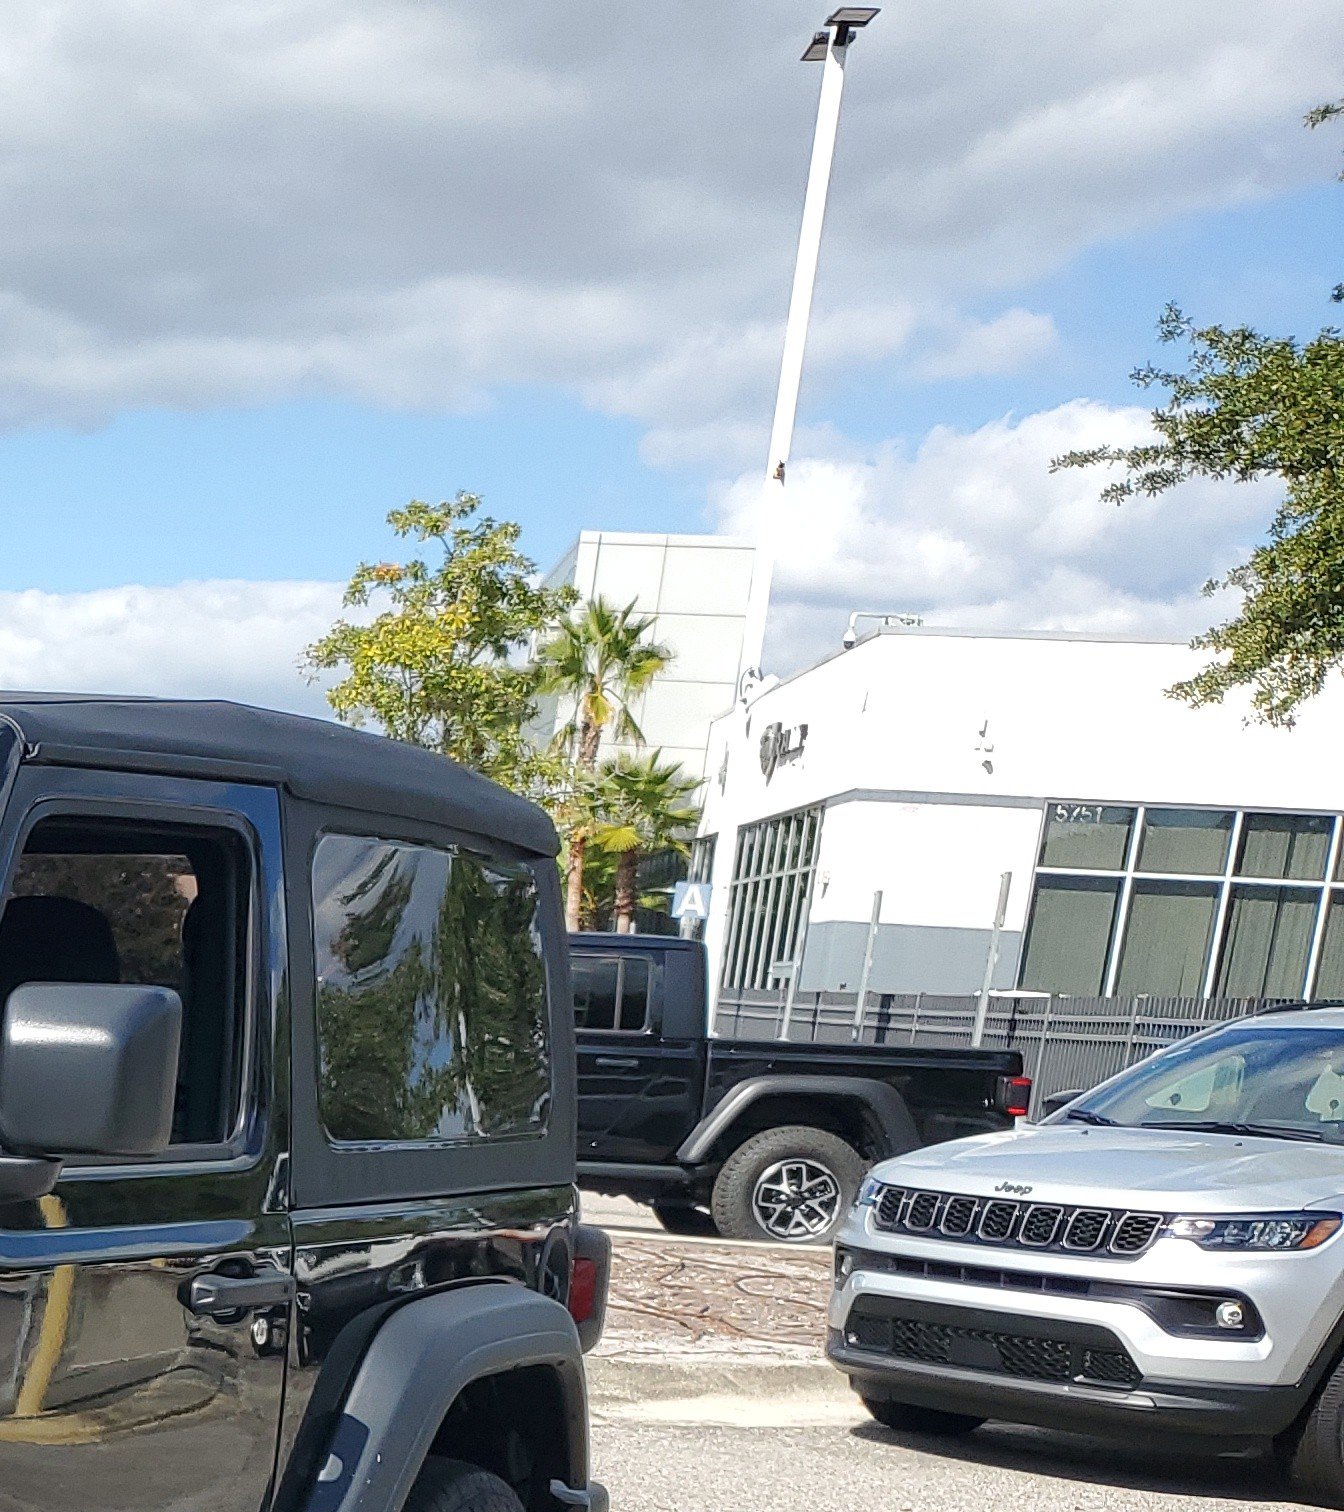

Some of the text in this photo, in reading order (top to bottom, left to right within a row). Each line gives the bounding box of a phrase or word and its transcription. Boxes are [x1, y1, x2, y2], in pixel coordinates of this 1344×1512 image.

[1055, 804, 1103, 824] 5751
[675, 884, 706, 917] A
[995, 1181, 1033, 1196] Jeep
